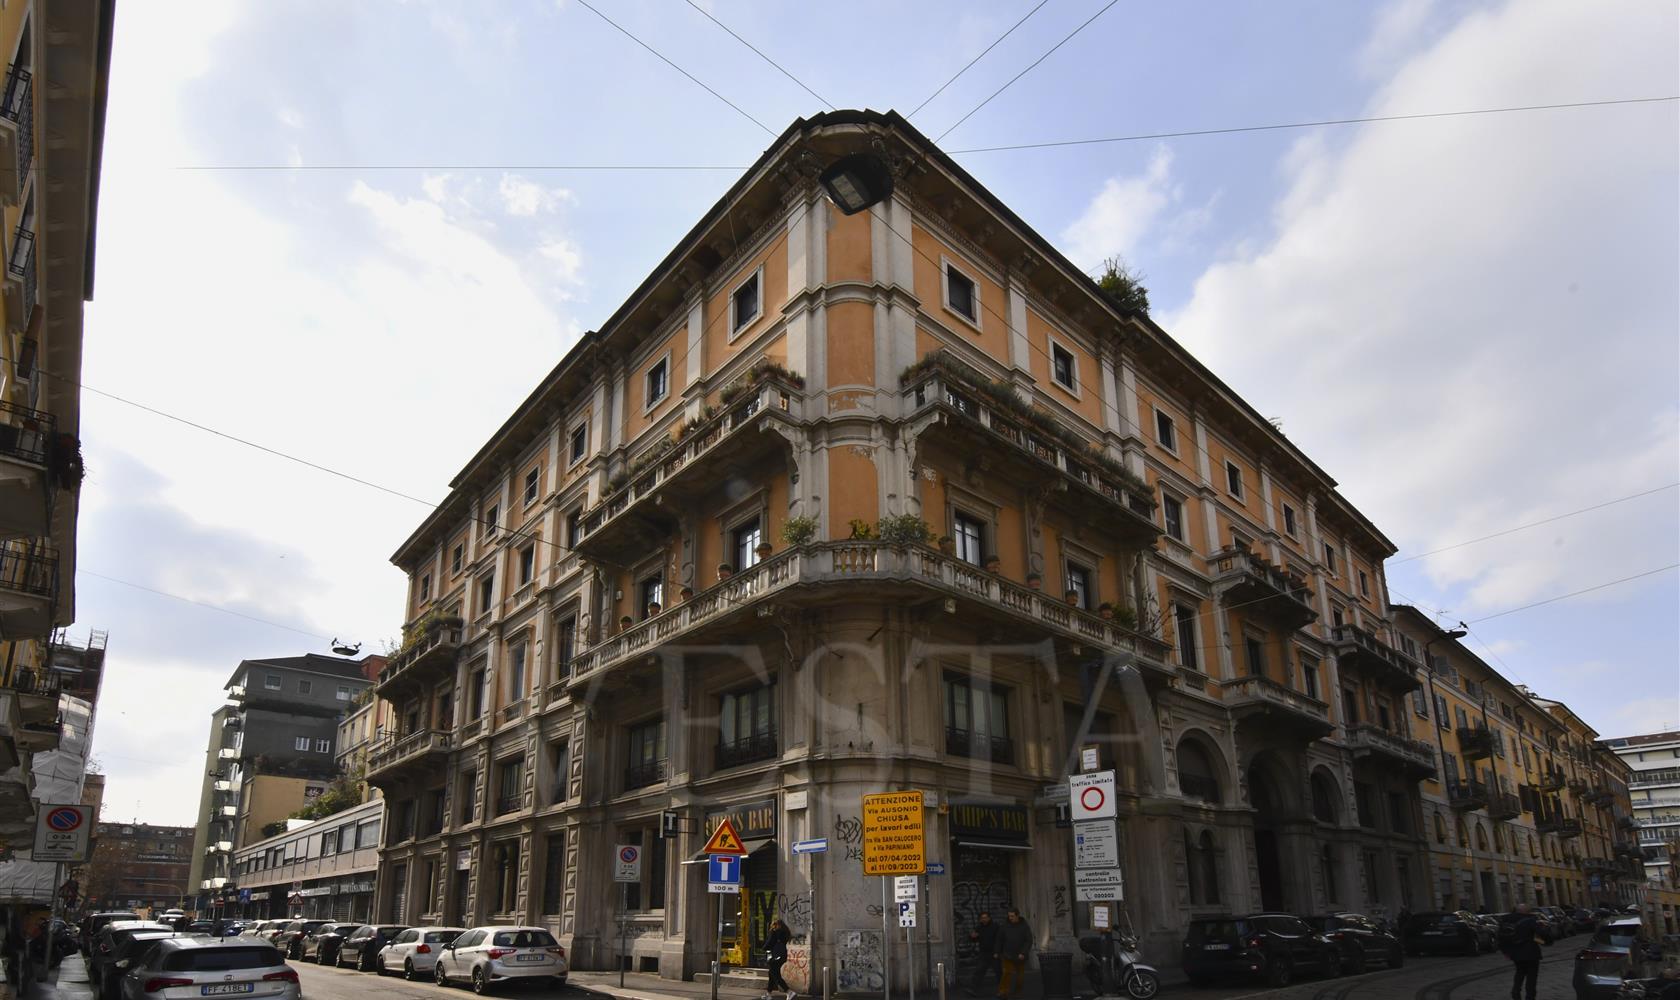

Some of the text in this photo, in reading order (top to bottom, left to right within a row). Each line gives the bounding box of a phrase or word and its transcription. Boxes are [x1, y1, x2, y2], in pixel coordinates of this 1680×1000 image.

[865, 796, 921, 806] ATTENZIONE
[881, 806, 917, 814] AUSONIO
[748, 808, 773, 831] BAR
[1002, 809, 1025, 832] BAR
[880, 854, 920, 862] 07/04/2022
[900, 902, 909, 916] P
